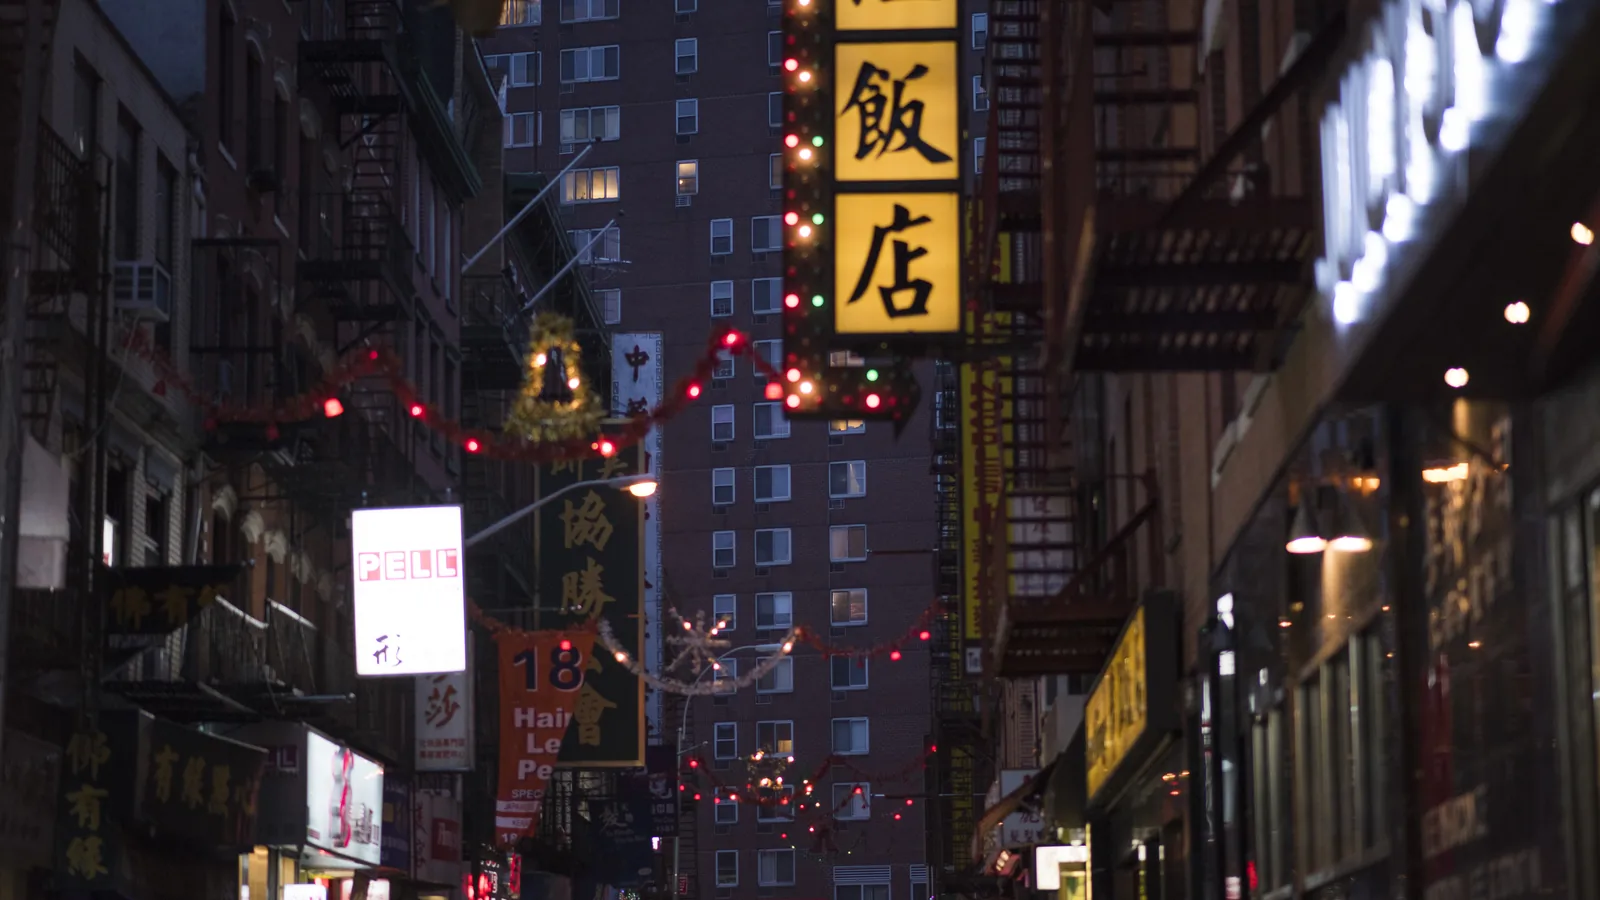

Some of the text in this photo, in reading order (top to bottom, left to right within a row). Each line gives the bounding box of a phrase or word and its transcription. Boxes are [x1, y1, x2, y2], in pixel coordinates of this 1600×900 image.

[836, 0, 954, 318] 飯店
[358, 549, 458, 582] PELL
[513, 644, 585, 692] 18
